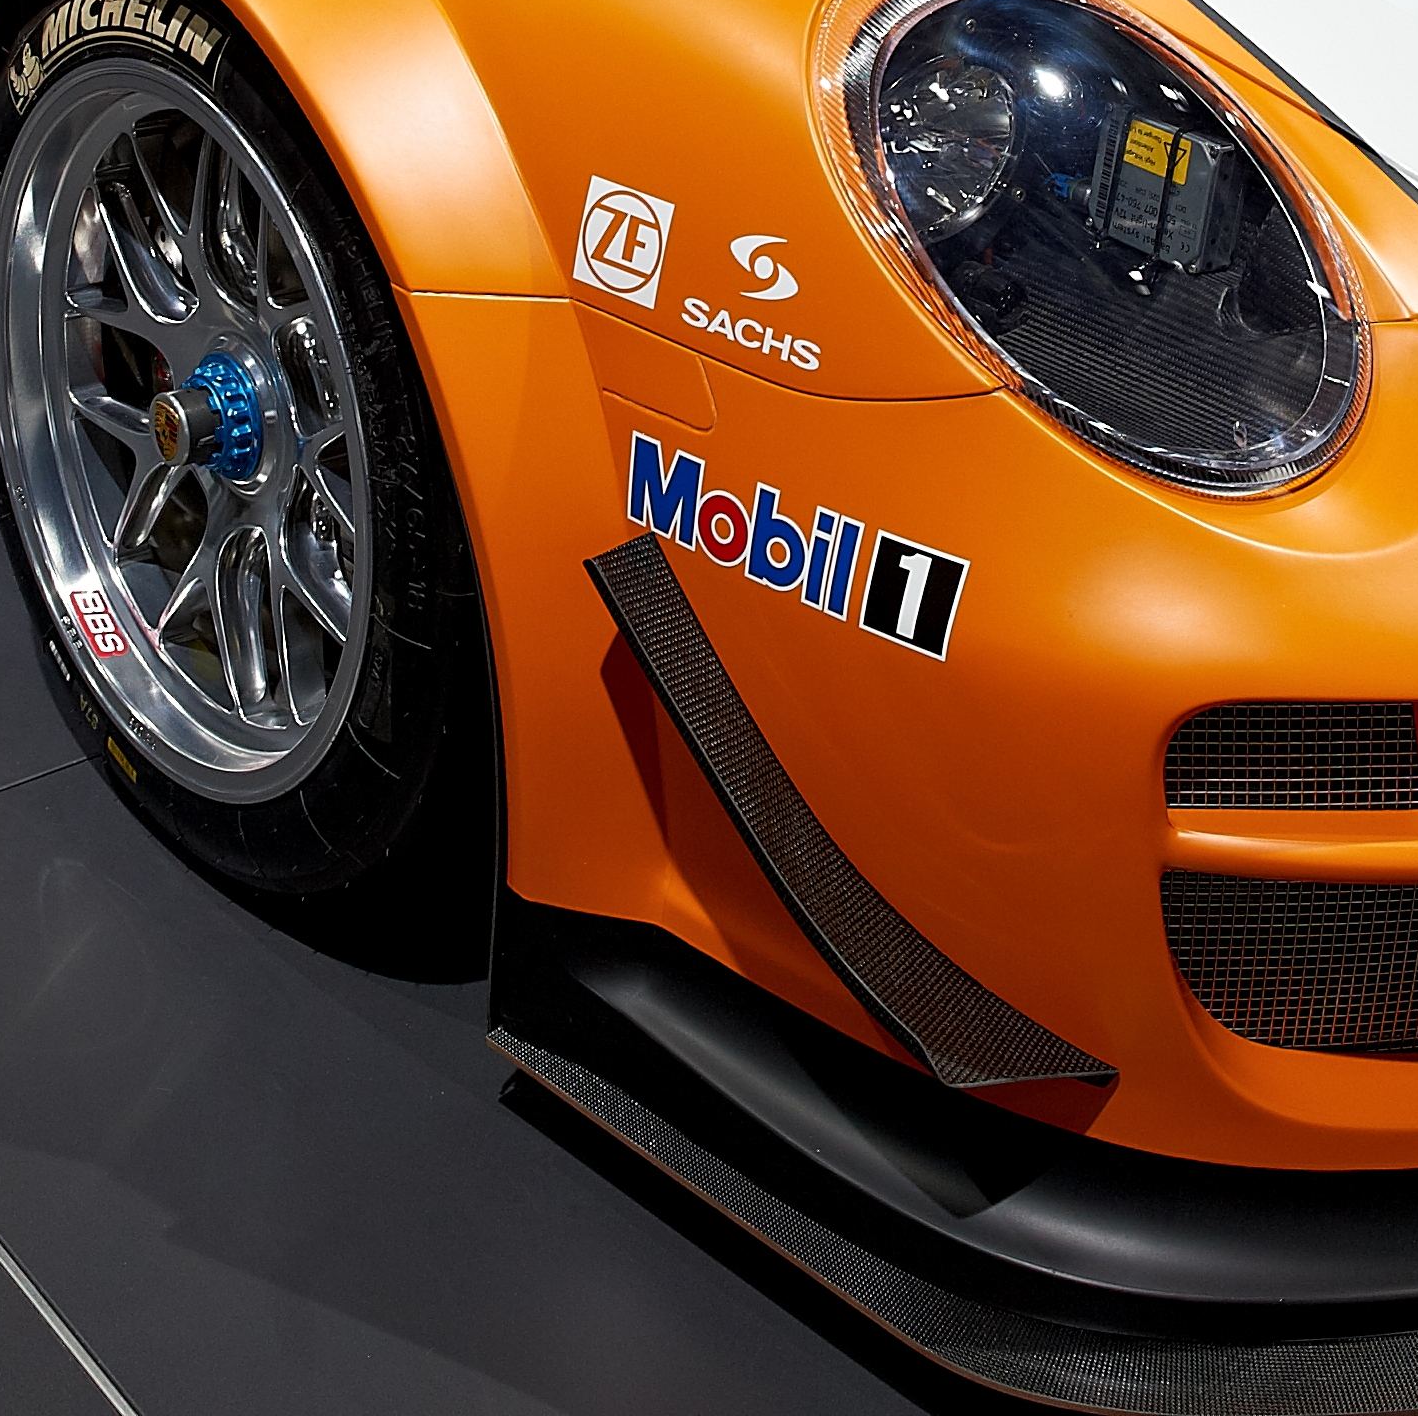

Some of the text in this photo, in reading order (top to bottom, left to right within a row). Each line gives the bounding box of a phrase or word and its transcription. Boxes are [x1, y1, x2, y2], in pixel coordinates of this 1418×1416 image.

[588, 202, 661, 281] ZF
[681, 297, 822, 371] SACHS
[627, 430, 933, 640] Mobil 1
[74, 591, 125, 654] BBS
